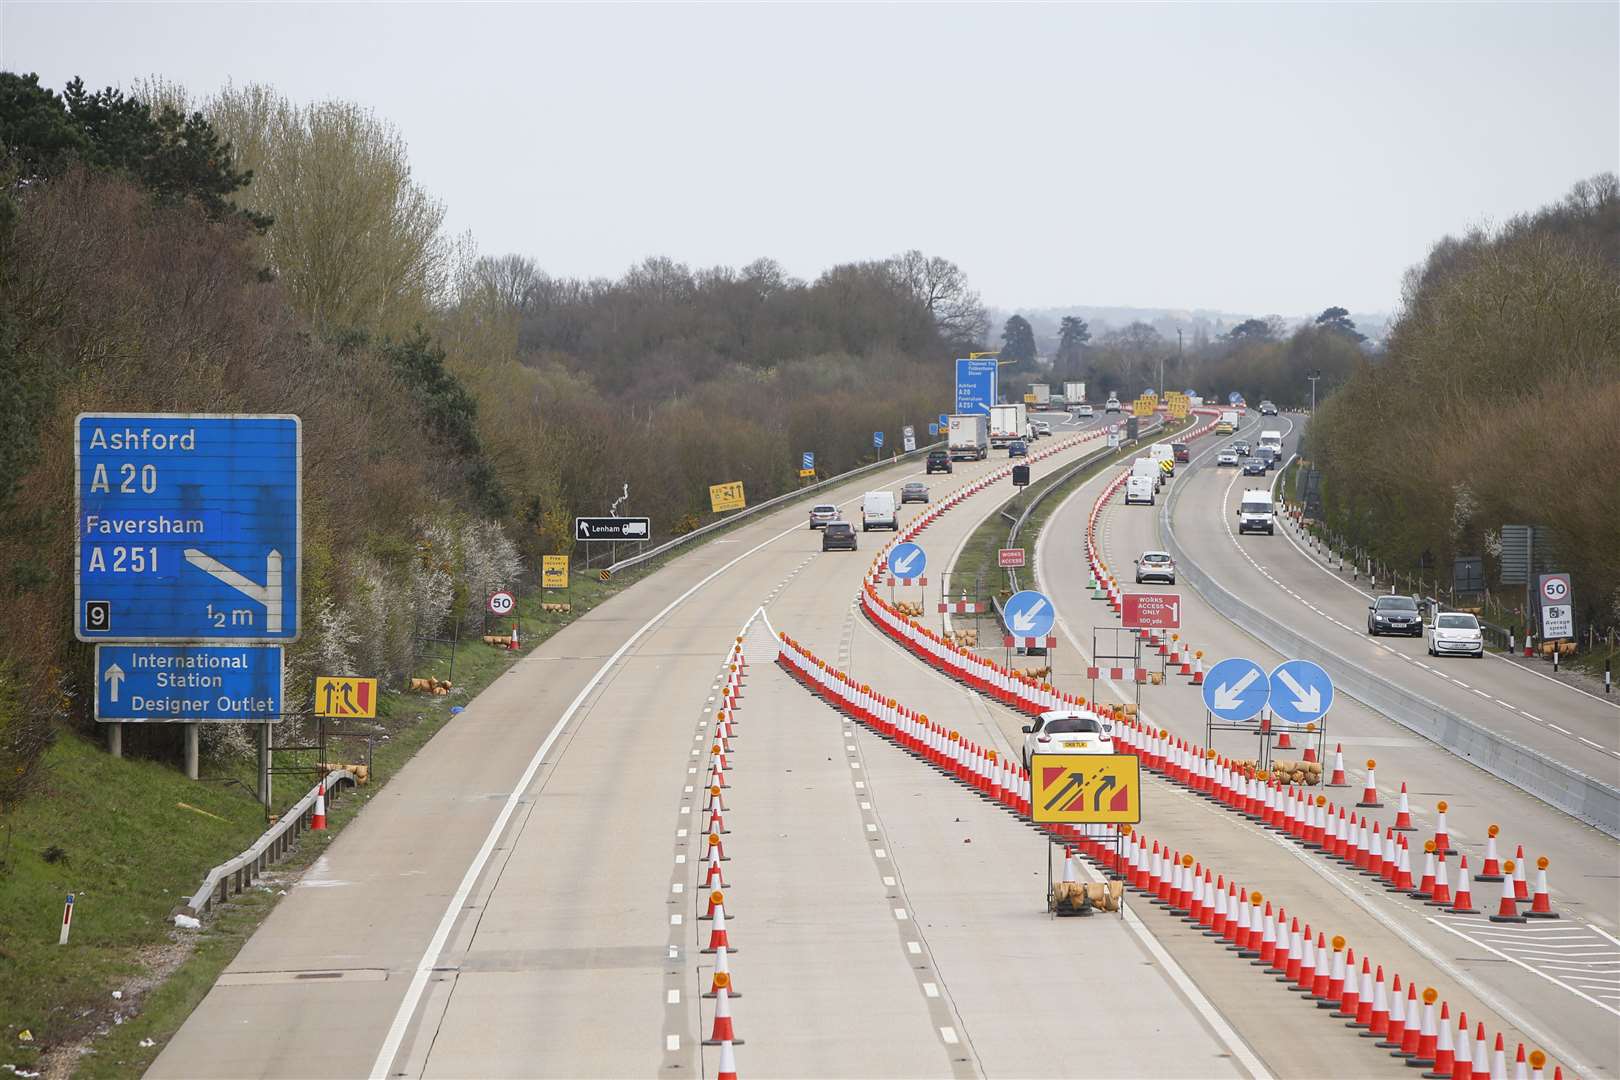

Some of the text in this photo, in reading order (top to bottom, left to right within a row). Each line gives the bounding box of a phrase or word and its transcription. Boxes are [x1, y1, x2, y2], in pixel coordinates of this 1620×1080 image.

[90, 428, 195, 450] Ashford
[87, 516, 204, 533] Faversham
[1546, 584, 1566, 594] 50
[493, 598, 510, 608] 50
[92, 606, 104, 625] 9
[232, 608, 253, 625] m
[132, 653, 248, 668] International
[157, 672, 222, 688] Station
[132, 696, 274, 714] Designer Outlet
